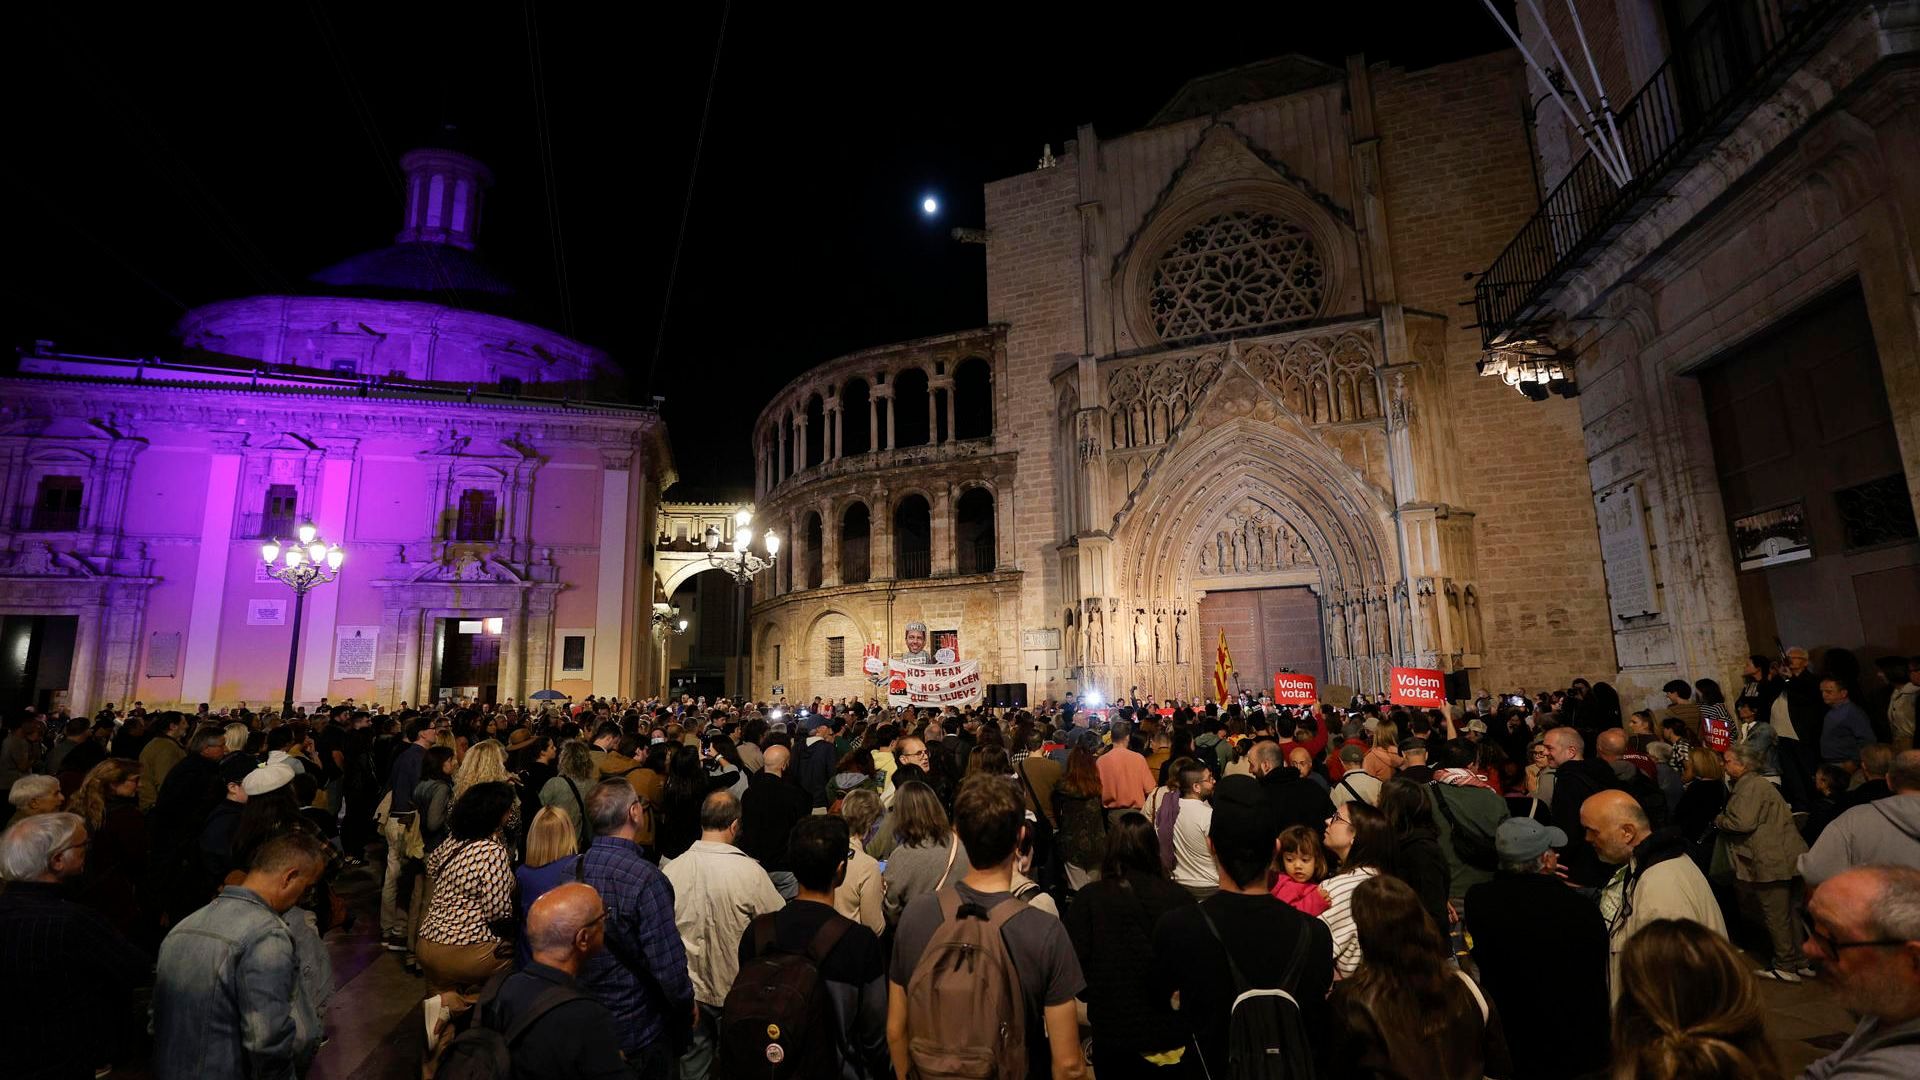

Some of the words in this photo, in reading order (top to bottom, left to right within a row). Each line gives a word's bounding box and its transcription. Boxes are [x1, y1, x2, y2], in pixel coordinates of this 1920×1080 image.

[908, 668, 926, 678] NOS
[935, 667, 962, 677] MEAN
[921, 683, 940, 692] NOS
[949, 672, 980, 688] DICEN
[1279, 679, 1313, 690] Volem
[1397, 674, 1440, 688] Volem
[911, 694, 928, 702] QUE
[939, 687, 976, 702] LLUEVE
[1281, 689, 1313, 699] votar.
[1399, 686, 1439, 699] votar.
